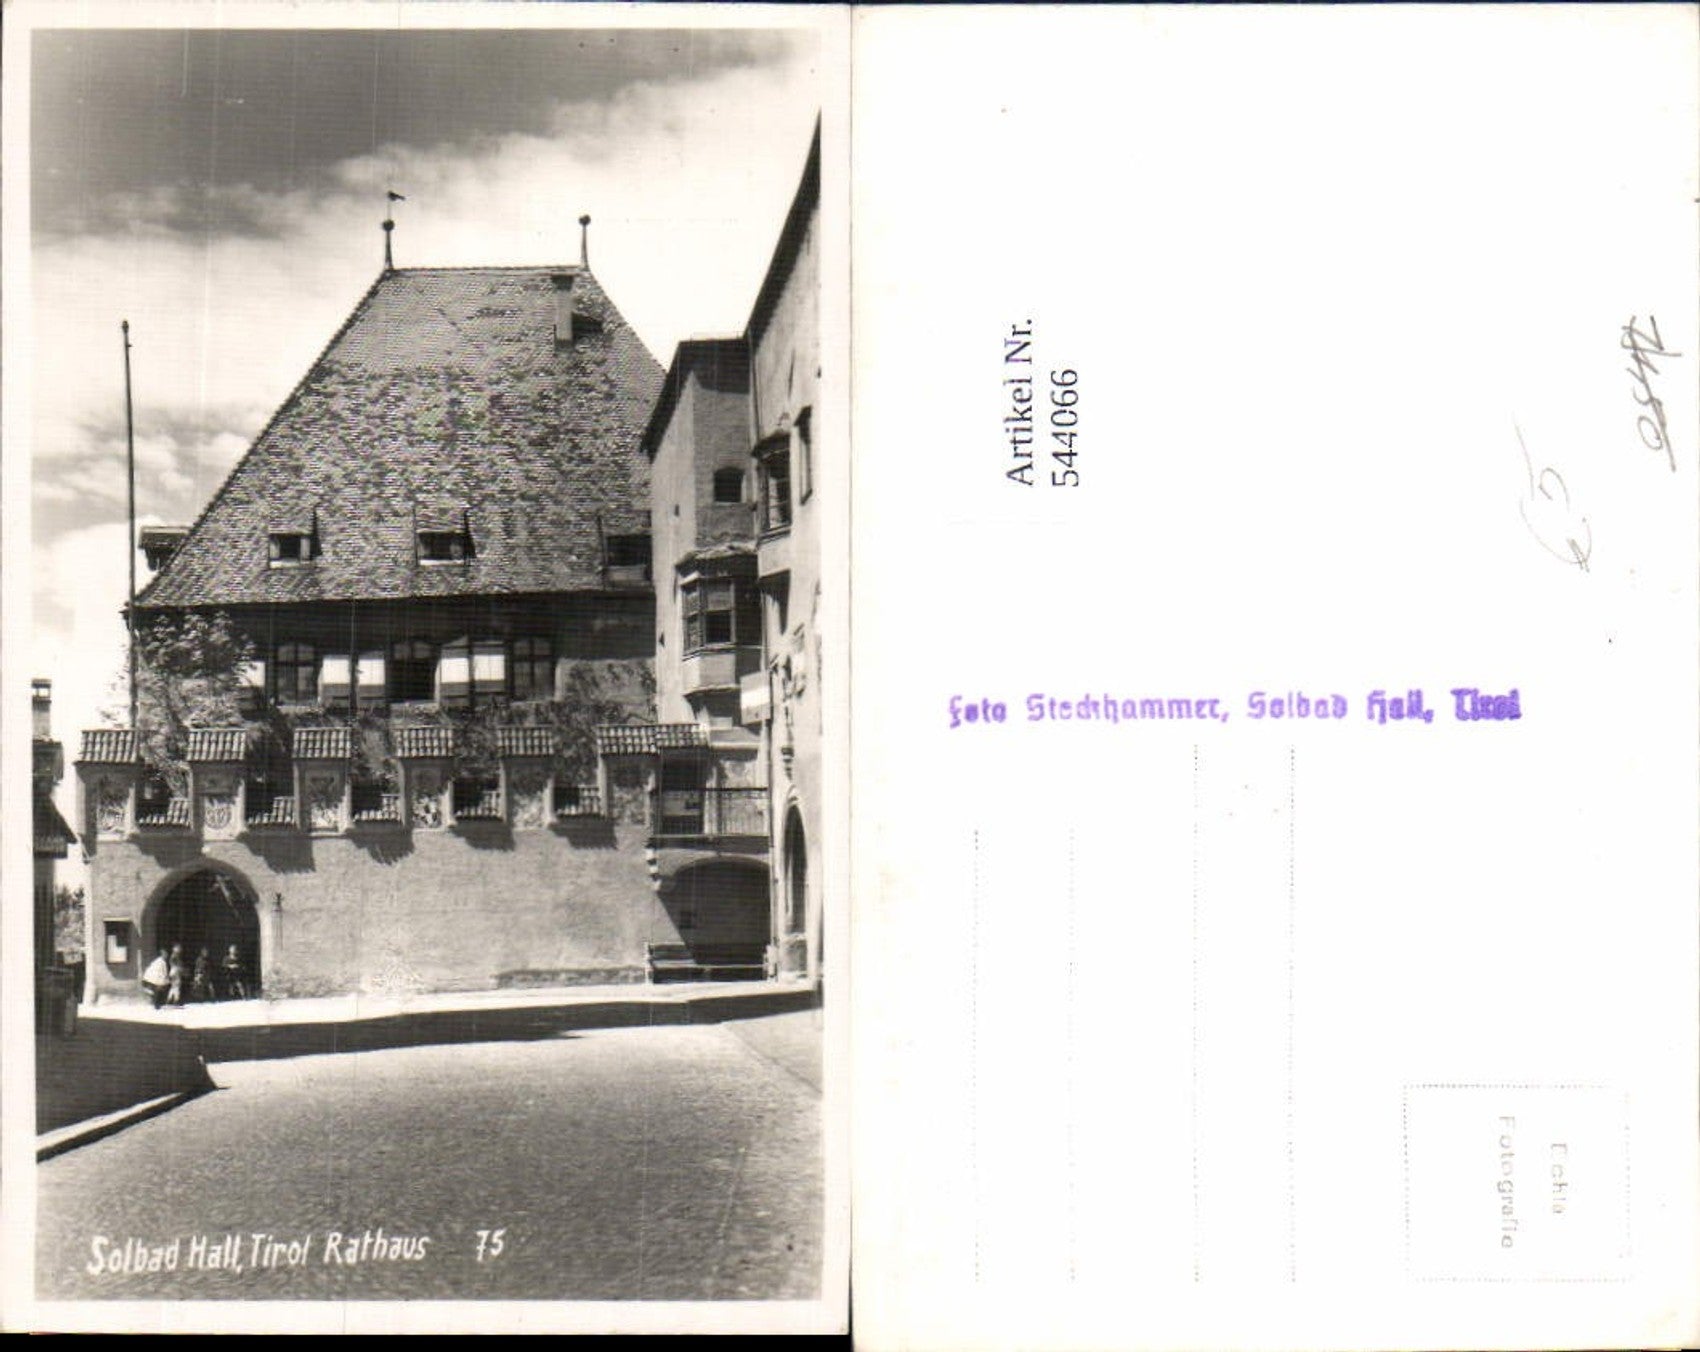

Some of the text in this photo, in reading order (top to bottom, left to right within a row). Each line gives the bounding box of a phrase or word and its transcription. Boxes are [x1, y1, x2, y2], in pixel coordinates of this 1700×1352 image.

[1003, 318, 1034, 488] Artikel Nr.
[1049, 368, 1080, 488] 544066
[948, 694, 1008, 730] Foto
[1246, 690, 1349, 720] Solbad
[1366, 688, 1435, 726] Hall,
[1496, 1116, 1518, 1248] Fotografie
